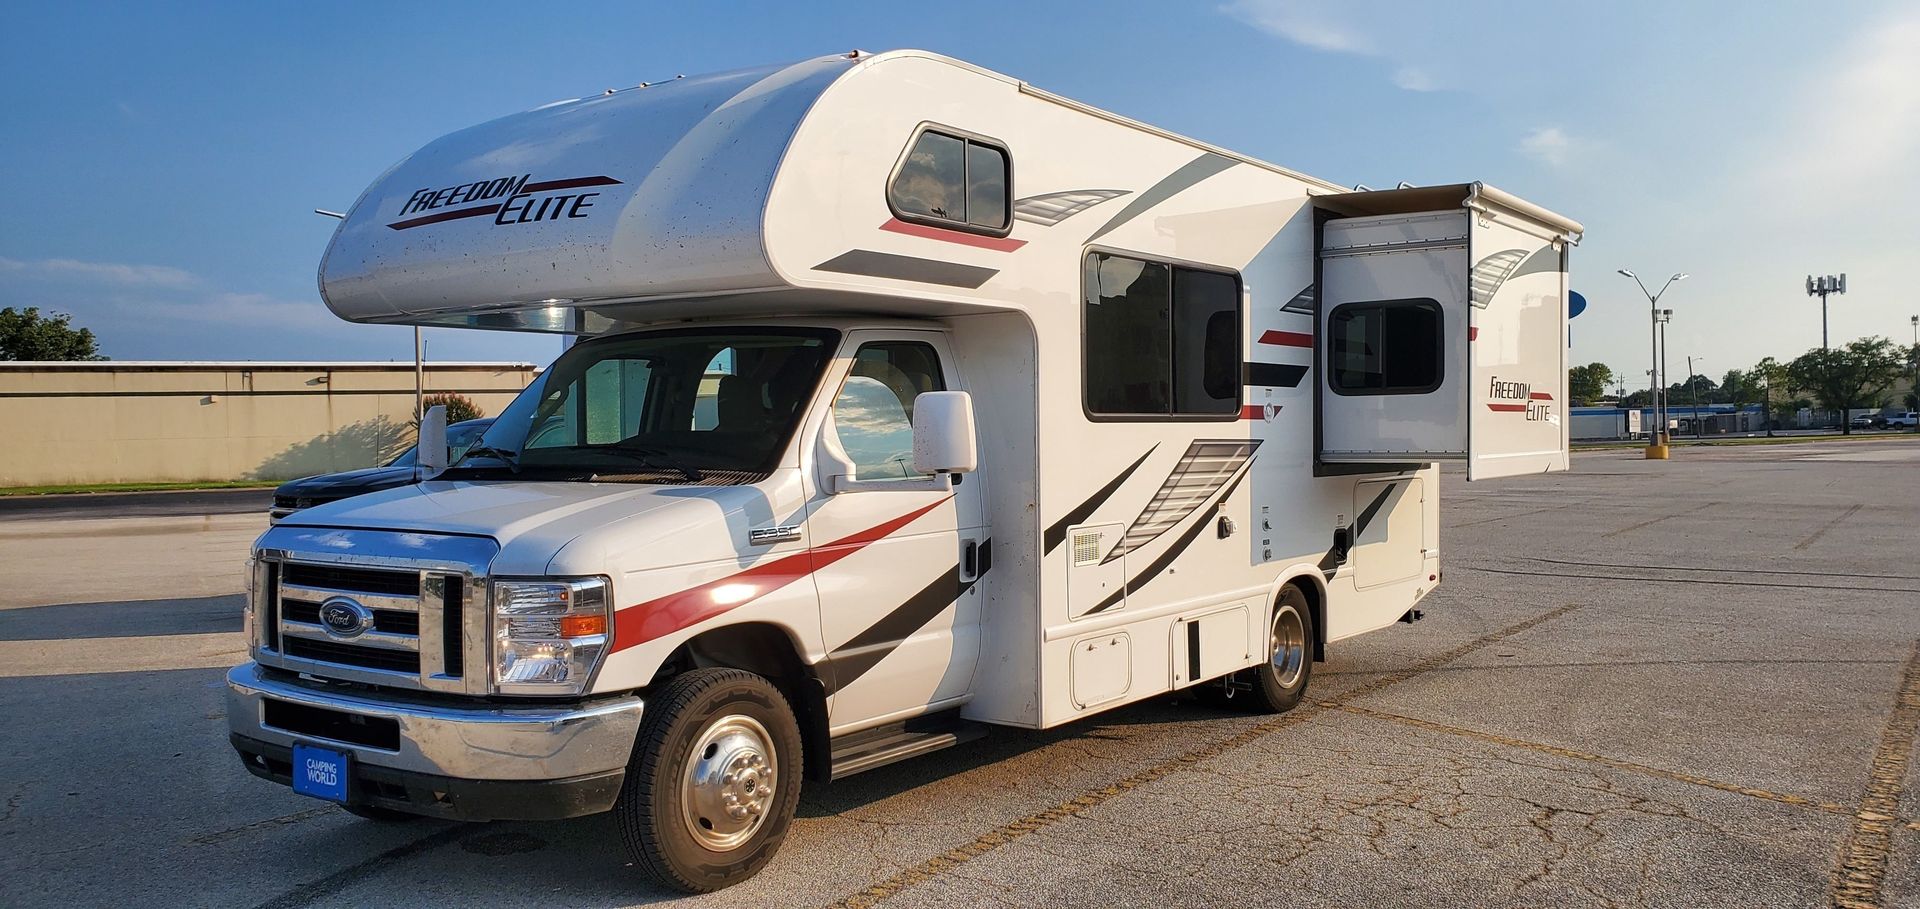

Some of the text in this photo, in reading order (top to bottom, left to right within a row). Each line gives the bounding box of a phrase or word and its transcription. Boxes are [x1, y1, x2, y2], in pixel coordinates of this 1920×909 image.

[398, 173, 533, 216] FREEDOM
[494, 192, 601, 226] ELITE
[1489, 376, 1531, 400] FREEDOM
[1526, 400, 1551, 421] ELITE
[328, 608, 350, 626] Ford
[306, 758, 337, 774] CAMPING
[306, 768, 338, 786] WORLD
